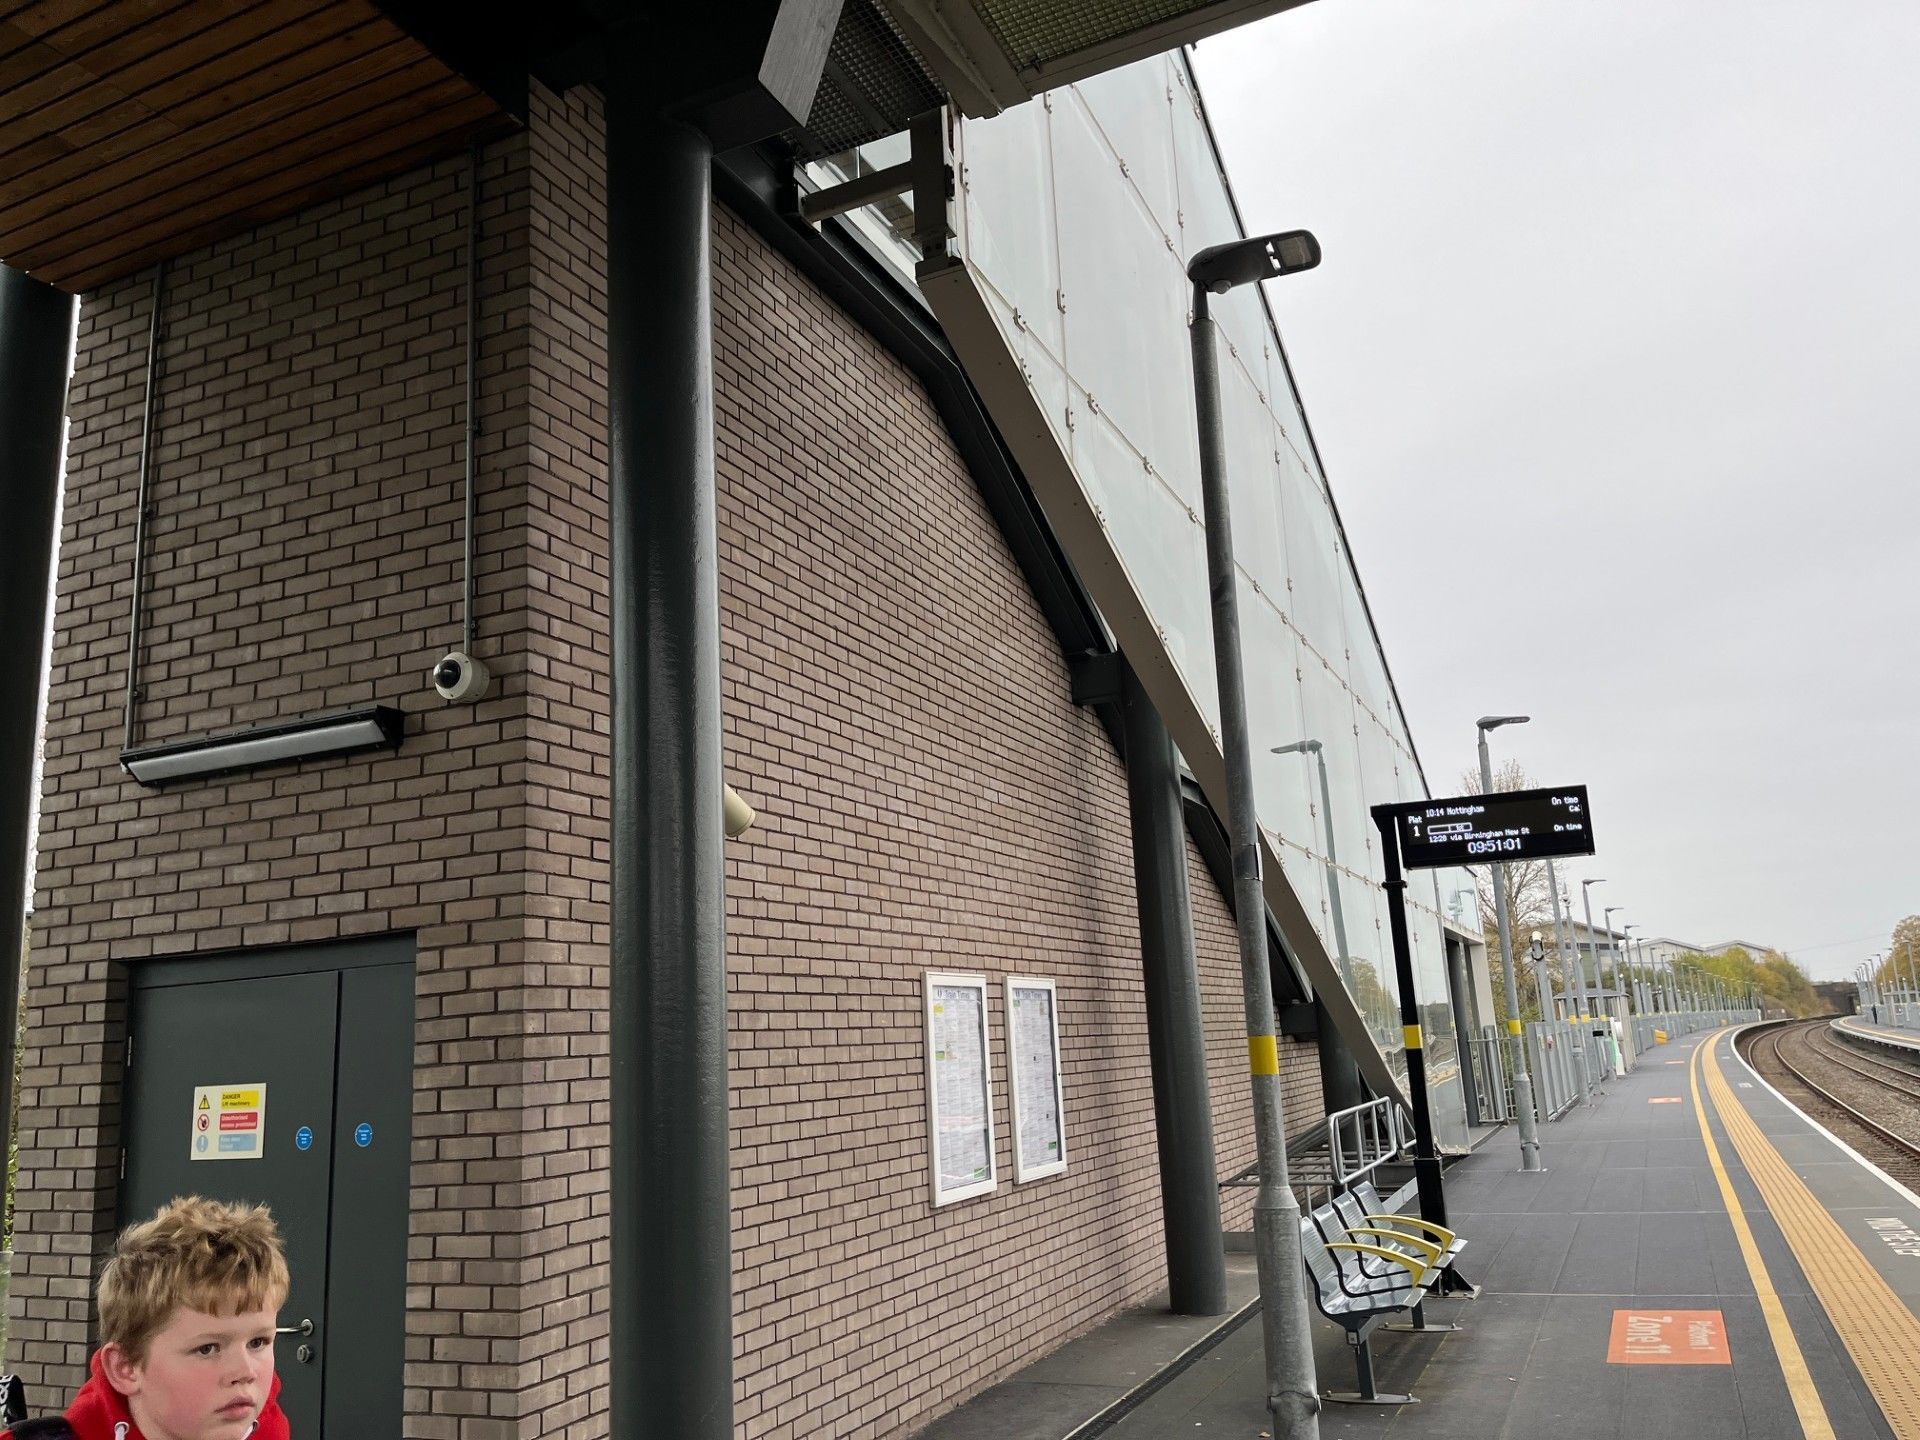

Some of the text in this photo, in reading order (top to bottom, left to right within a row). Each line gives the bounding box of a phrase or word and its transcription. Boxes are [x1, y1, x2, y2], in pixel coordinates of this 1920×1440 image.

[1551, 796, 1578, 805] On time
[1426, 805, 1485, 817] 10:14 Nottingham
[1408, 815, 1422, 824] Plat
[1413, 825, 1420, 836] 1
[1553, 823, 1582, 832] On time
[1450, 833, 1463, 841] via
[1464, 830, 1504, 841] Birmingham
[1505, 828, 1519, 836] New
[1467, 838, 1522, 854] 09:51:01
[1624, 1316, 1672, 1354] Zone 11
